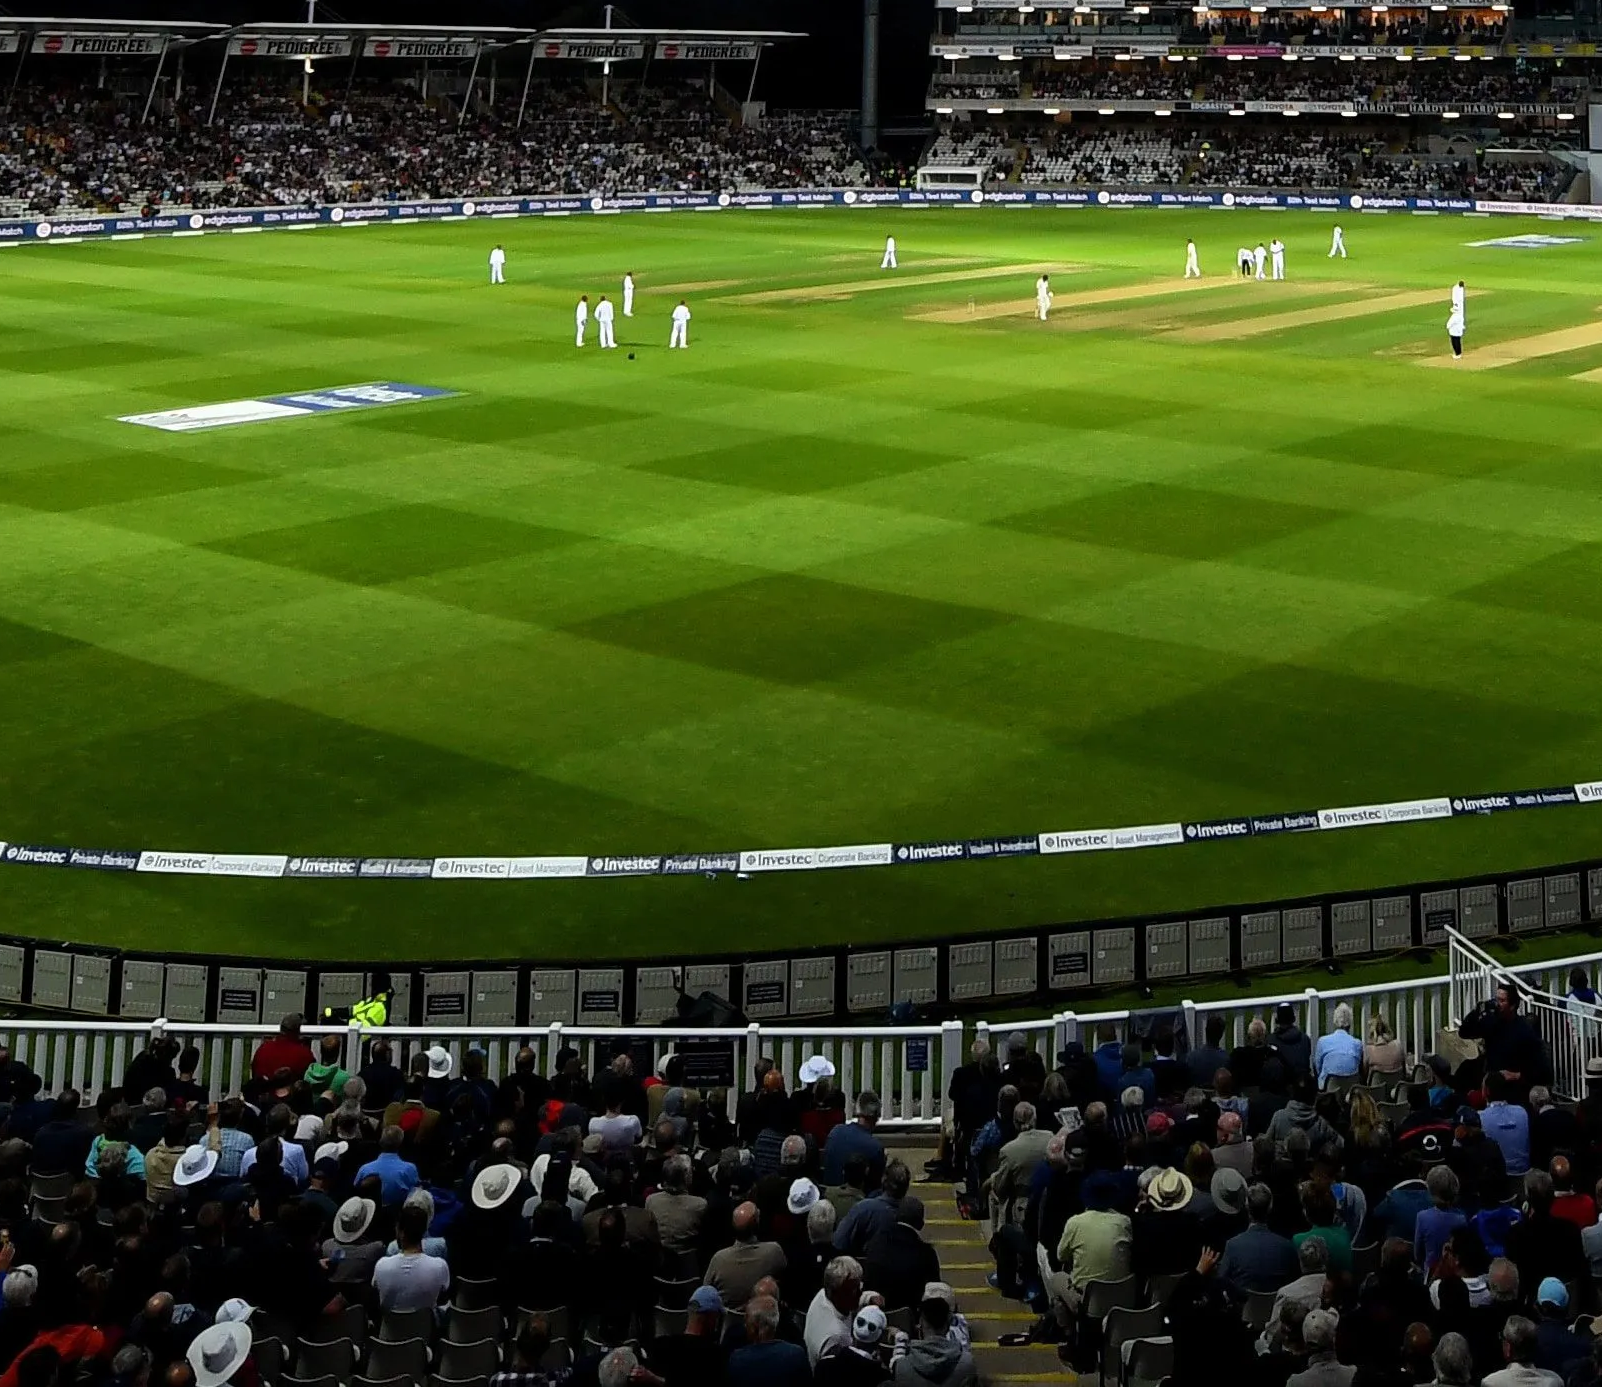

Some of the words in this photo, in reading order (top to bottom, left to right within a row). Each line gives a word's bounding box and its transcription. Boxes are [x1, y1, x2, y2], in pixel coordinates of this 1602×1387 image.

[72, 38, 145, 52] PEDIGREE
[266, 42, 335, 54] PEDIGREE
[397, 42, 461, 56] PEDIGREE
[205, 214, 253, 226] edgbaston
[52, 222, 104, 234] edgbaston
[1462, 796, 1510, 810] Investec
[1333, 809, 1381, 823] Investec
[1195, 823, 1247, 836] Investec
[1056, 835, 1108, 848] Investec
[16, 848, 66, 863] Investec
[909, 844, 963, 859] Investec
[154, 856, 207, 869] Investec
[300, 859, 356, 873] Investec
[603, 857, 659, 871] Investec
[758, 854, 811, 866] Investec
[450, 861, 505, 874] Investec
